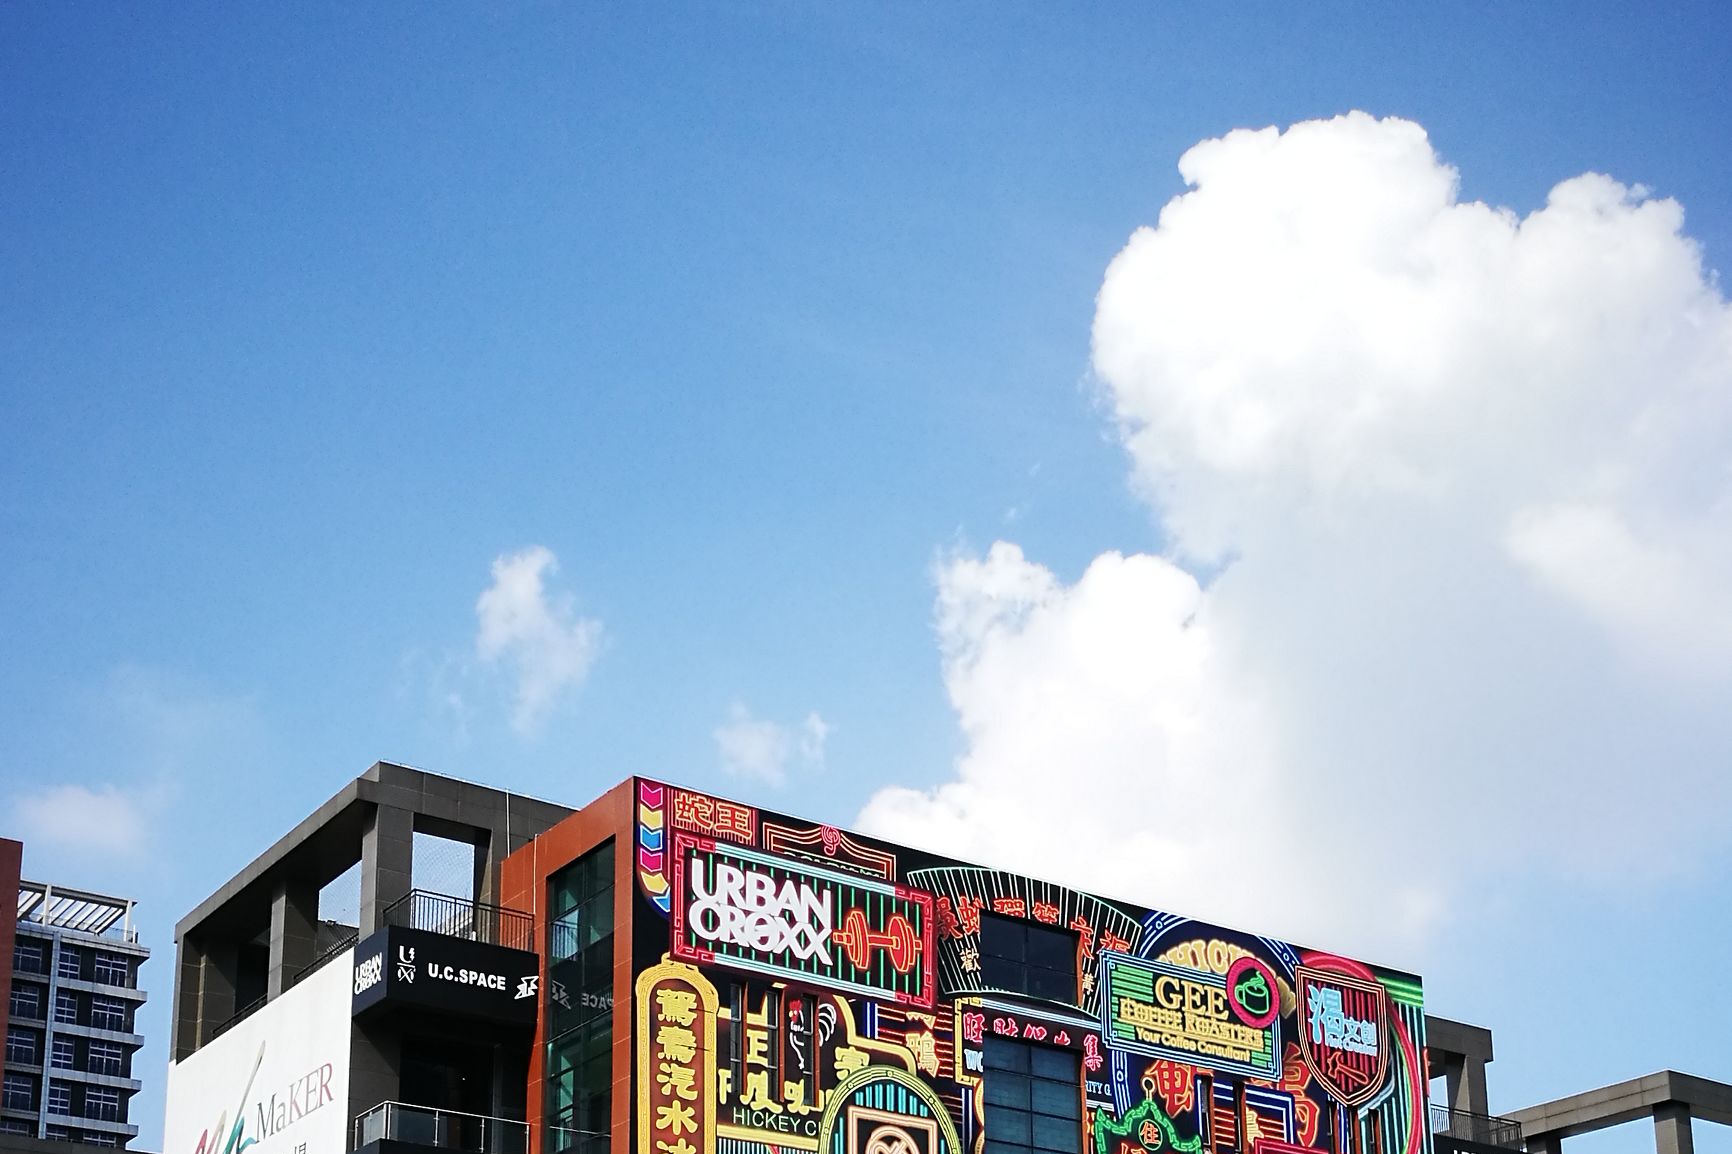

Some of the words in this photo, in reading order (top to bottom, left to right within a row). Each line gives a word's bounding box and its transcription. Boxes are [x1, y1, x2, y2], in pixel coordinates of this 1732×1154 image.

[674, 793, 752, 840] 蛇王
[691, 857, 833, 931] URBAN
[355, 953, 382, 981] URBAN
[428, 962, 506, 991] U.C.SPACE
[1155, 975, 1229, 1020] GEE
[1135, 1027, 1161, 1044] Your
[1161, 1033, 1197, 1052] Coffee
[1197, 1041, 1251, 1062] Consultant
